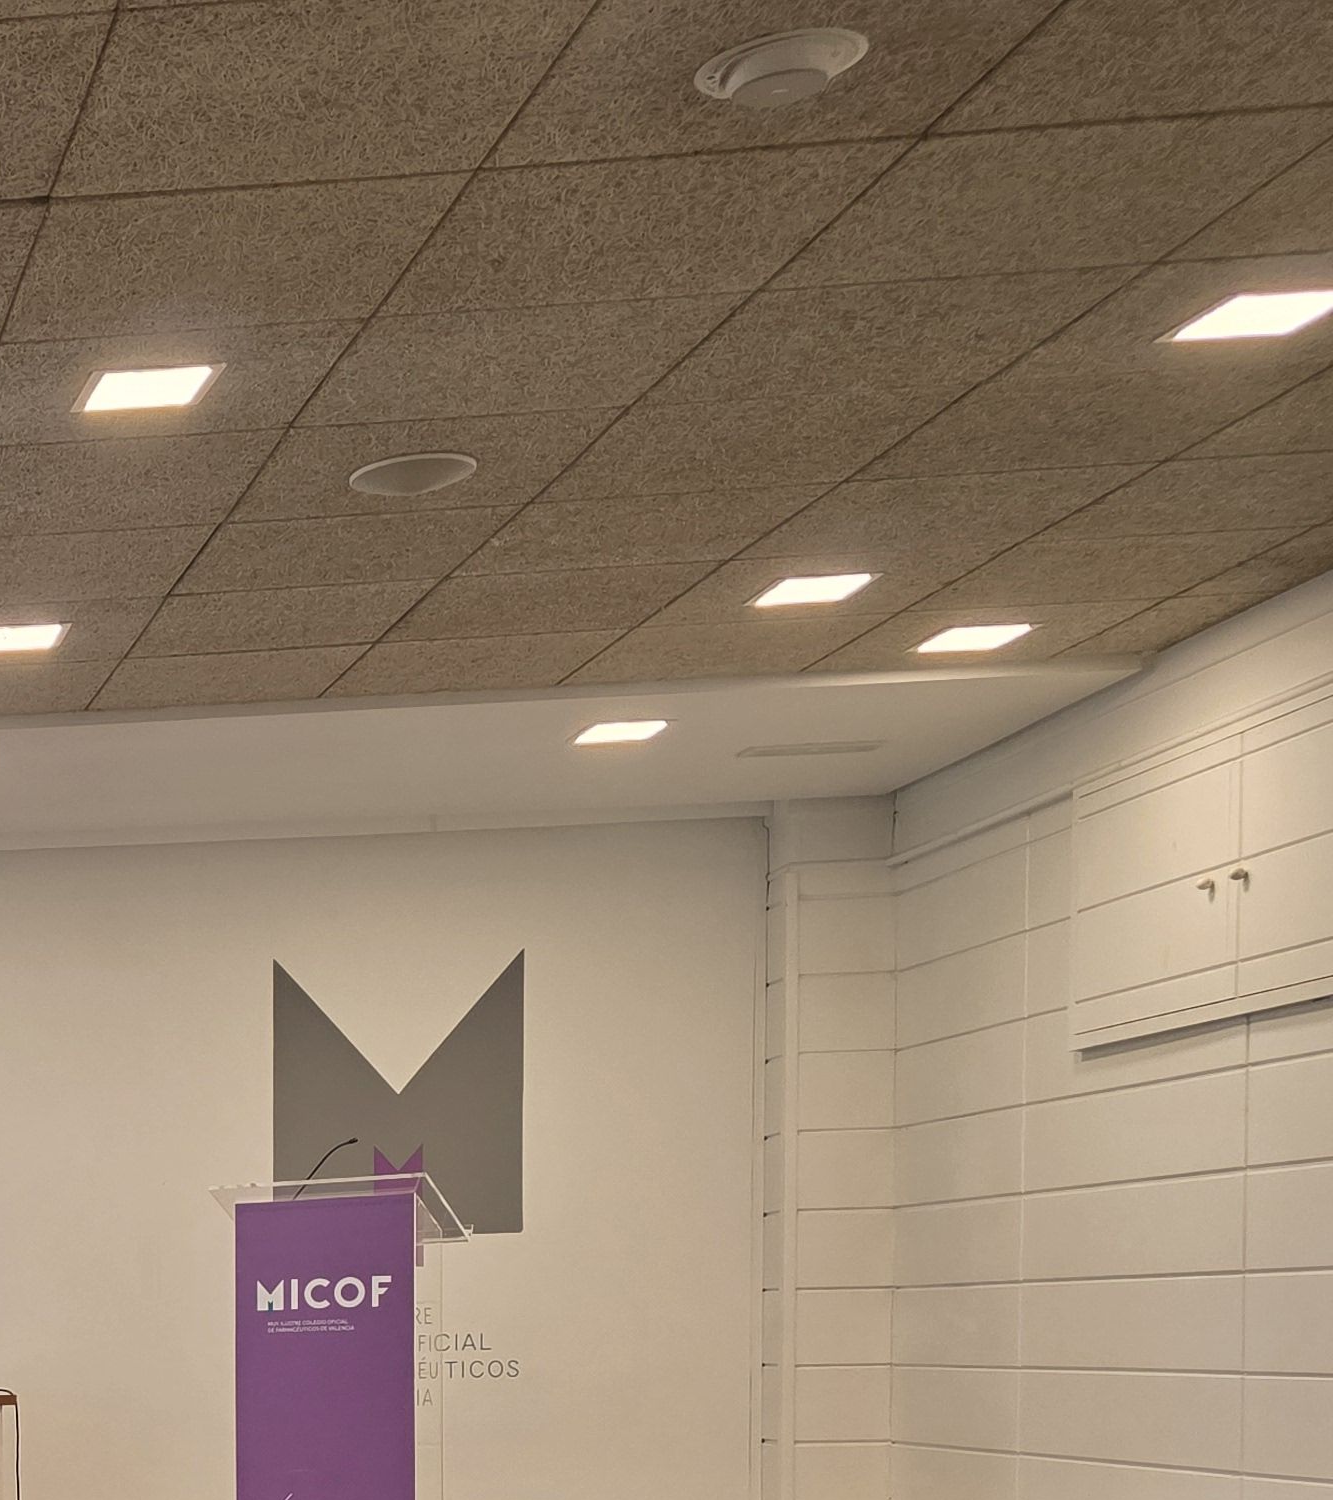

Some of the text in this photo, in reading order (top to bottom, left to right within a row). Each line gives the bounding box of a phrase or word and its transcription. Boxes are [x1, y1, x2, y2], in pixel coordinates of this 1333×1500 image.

[256, 1275, 392, 1311] MICOF
[418, 1333, 492, 1352] FICIAL
[418, 1357, 519, 1379] ÉUTICOS
